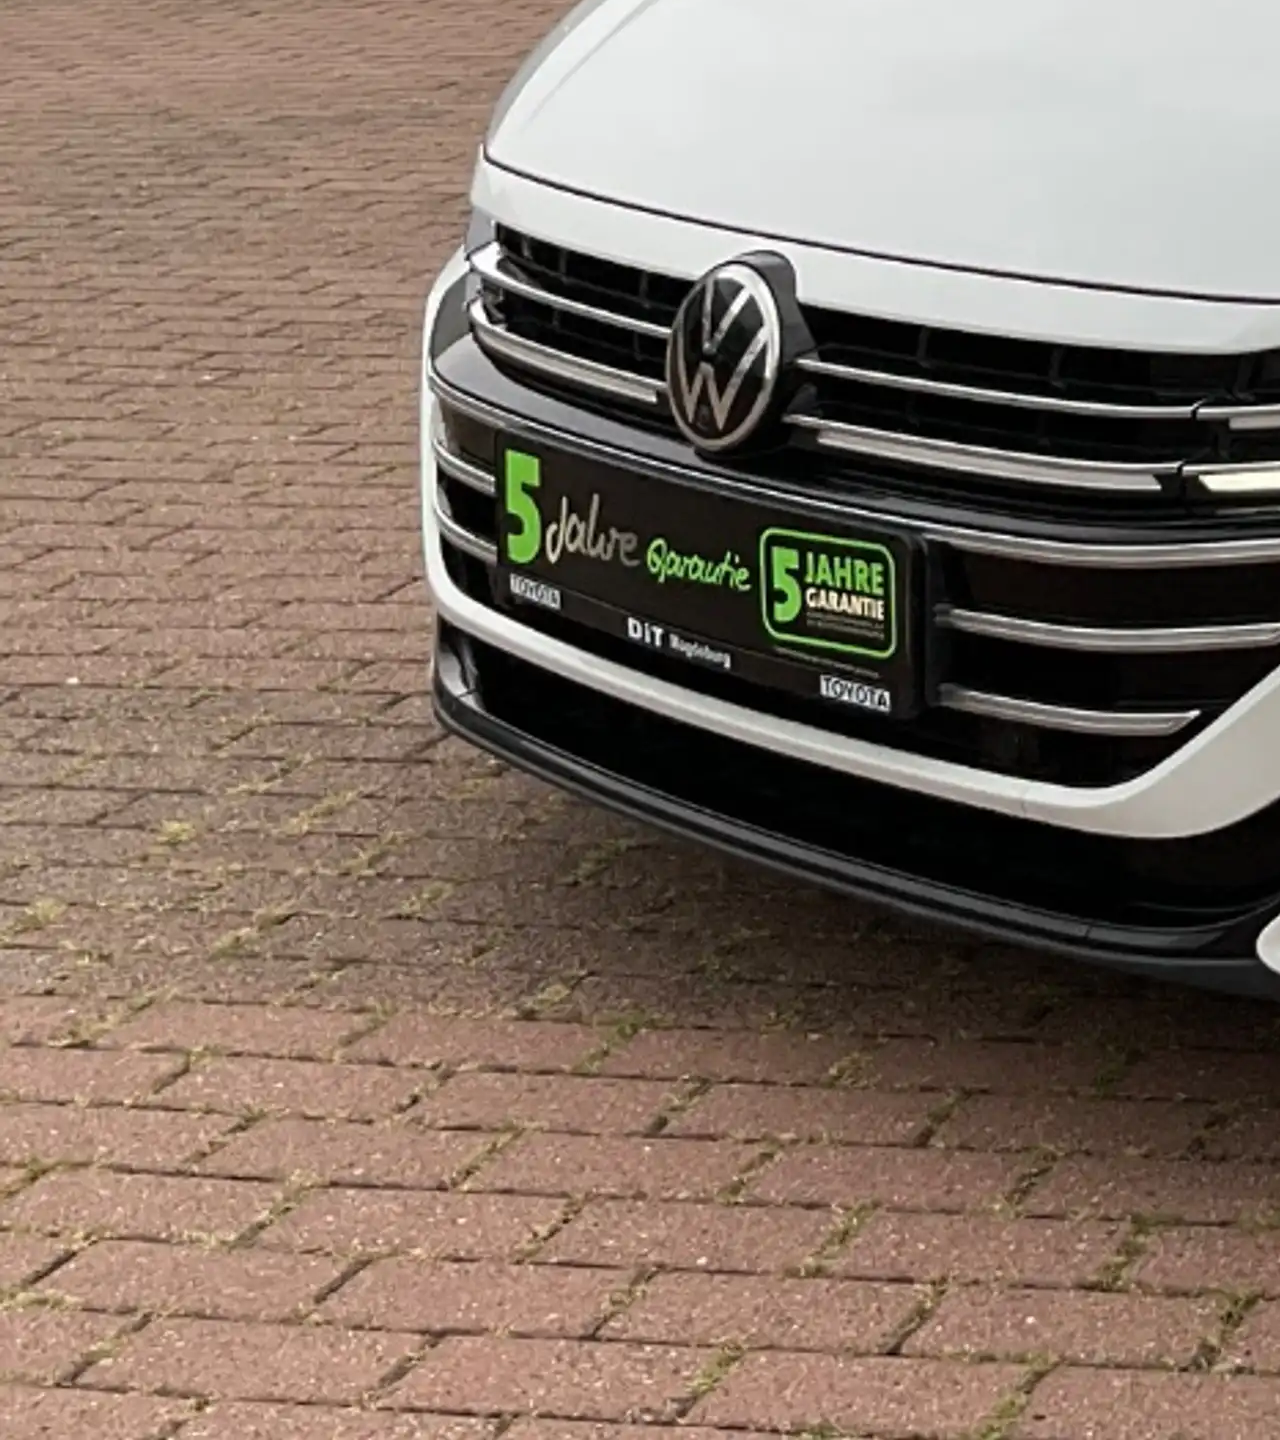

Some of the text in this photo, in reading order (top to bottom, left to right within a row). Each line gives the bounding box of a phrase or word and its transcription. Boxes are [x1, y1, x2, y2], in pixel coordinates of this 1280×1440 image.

[505, 448, 542, 564] 5
[545, 492, 641, 567] Jahre
[771, 546, 802, 623] 5
[804, 551, 885, 595] JAHRE
[805, 587, 885, 621] GARANTIE
[820, 674, 891, 712] TOYOTA
